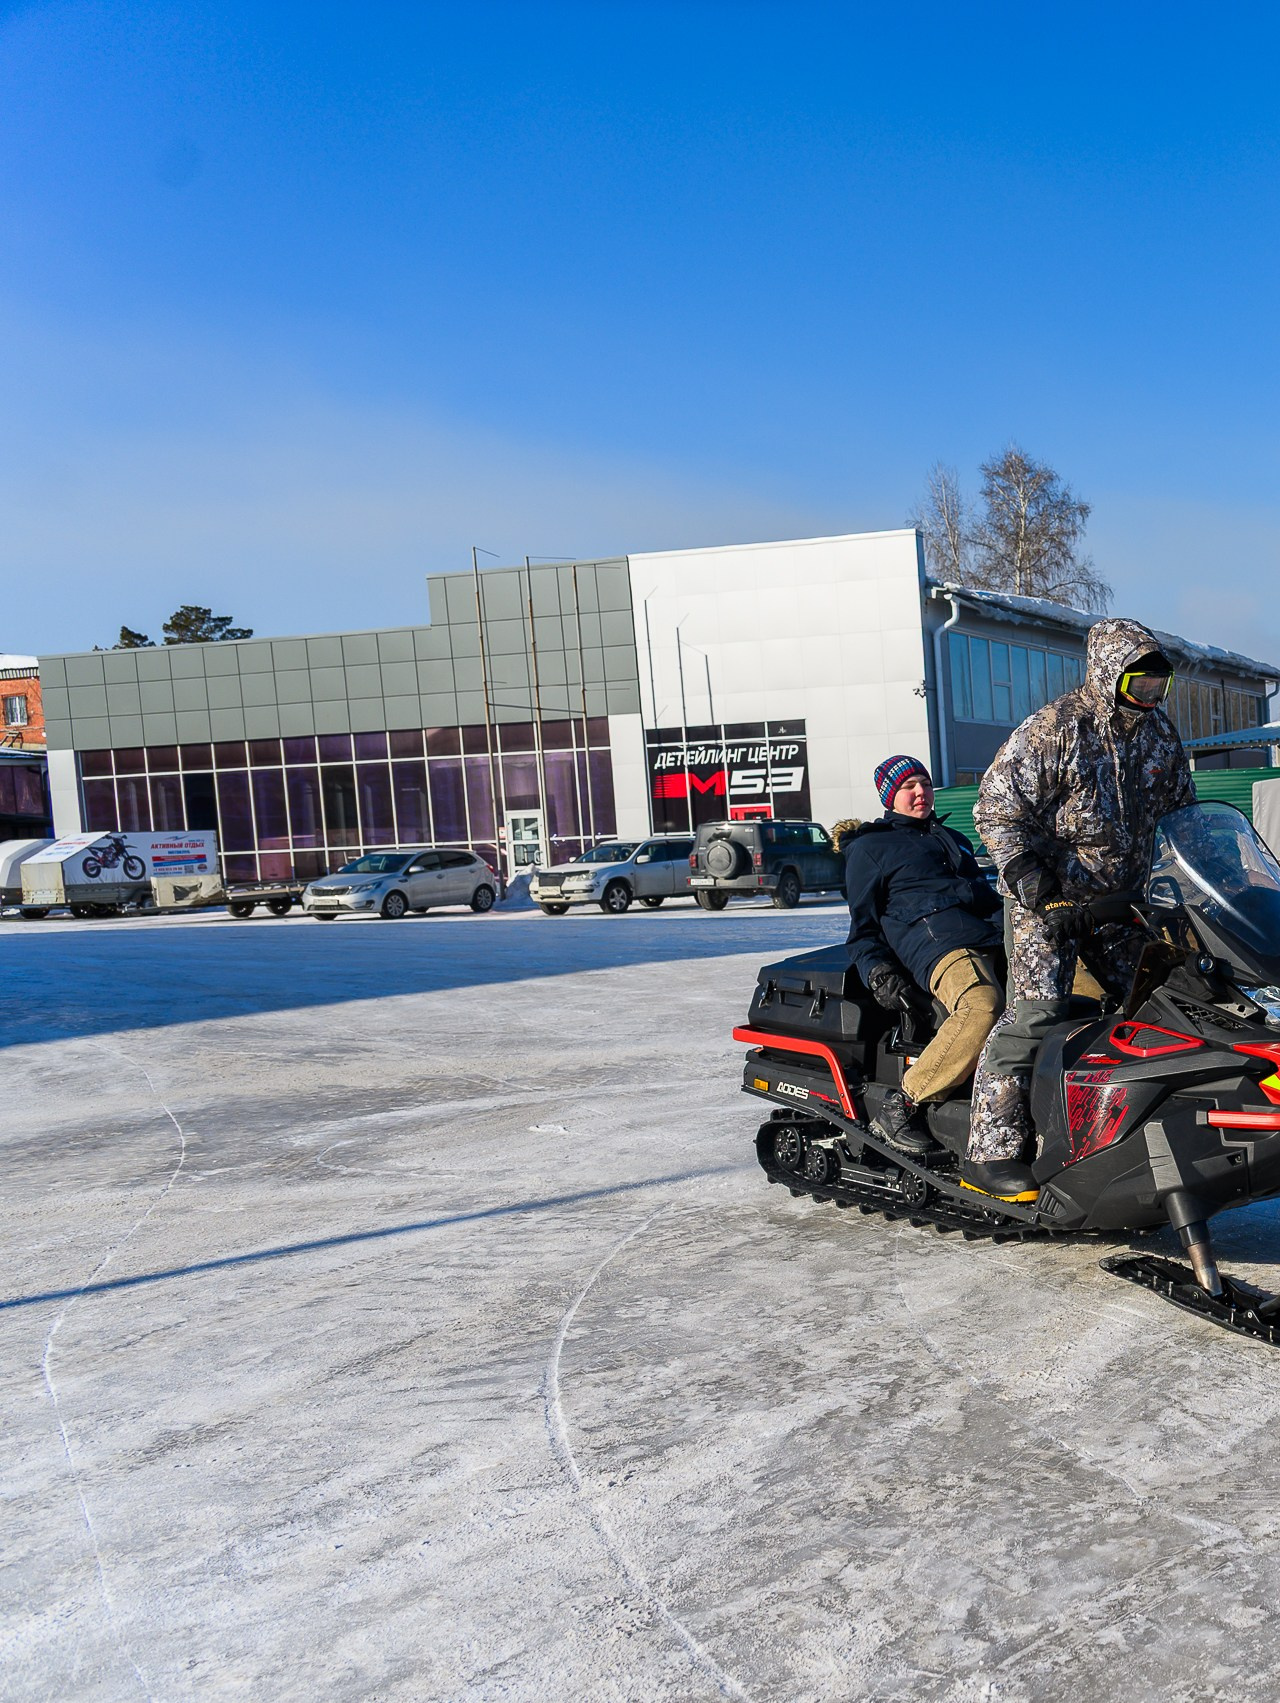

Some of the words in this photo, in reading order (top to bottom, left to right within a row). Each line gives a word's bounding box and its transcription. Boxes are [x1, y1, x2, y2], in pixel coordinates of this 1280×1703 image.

[654, 746, 747, 770] ДЕТЕЙЛИНГ
[748, 744, 799, 764] ЦЕНТР
[776, 1081, 810, 1100] AODES
